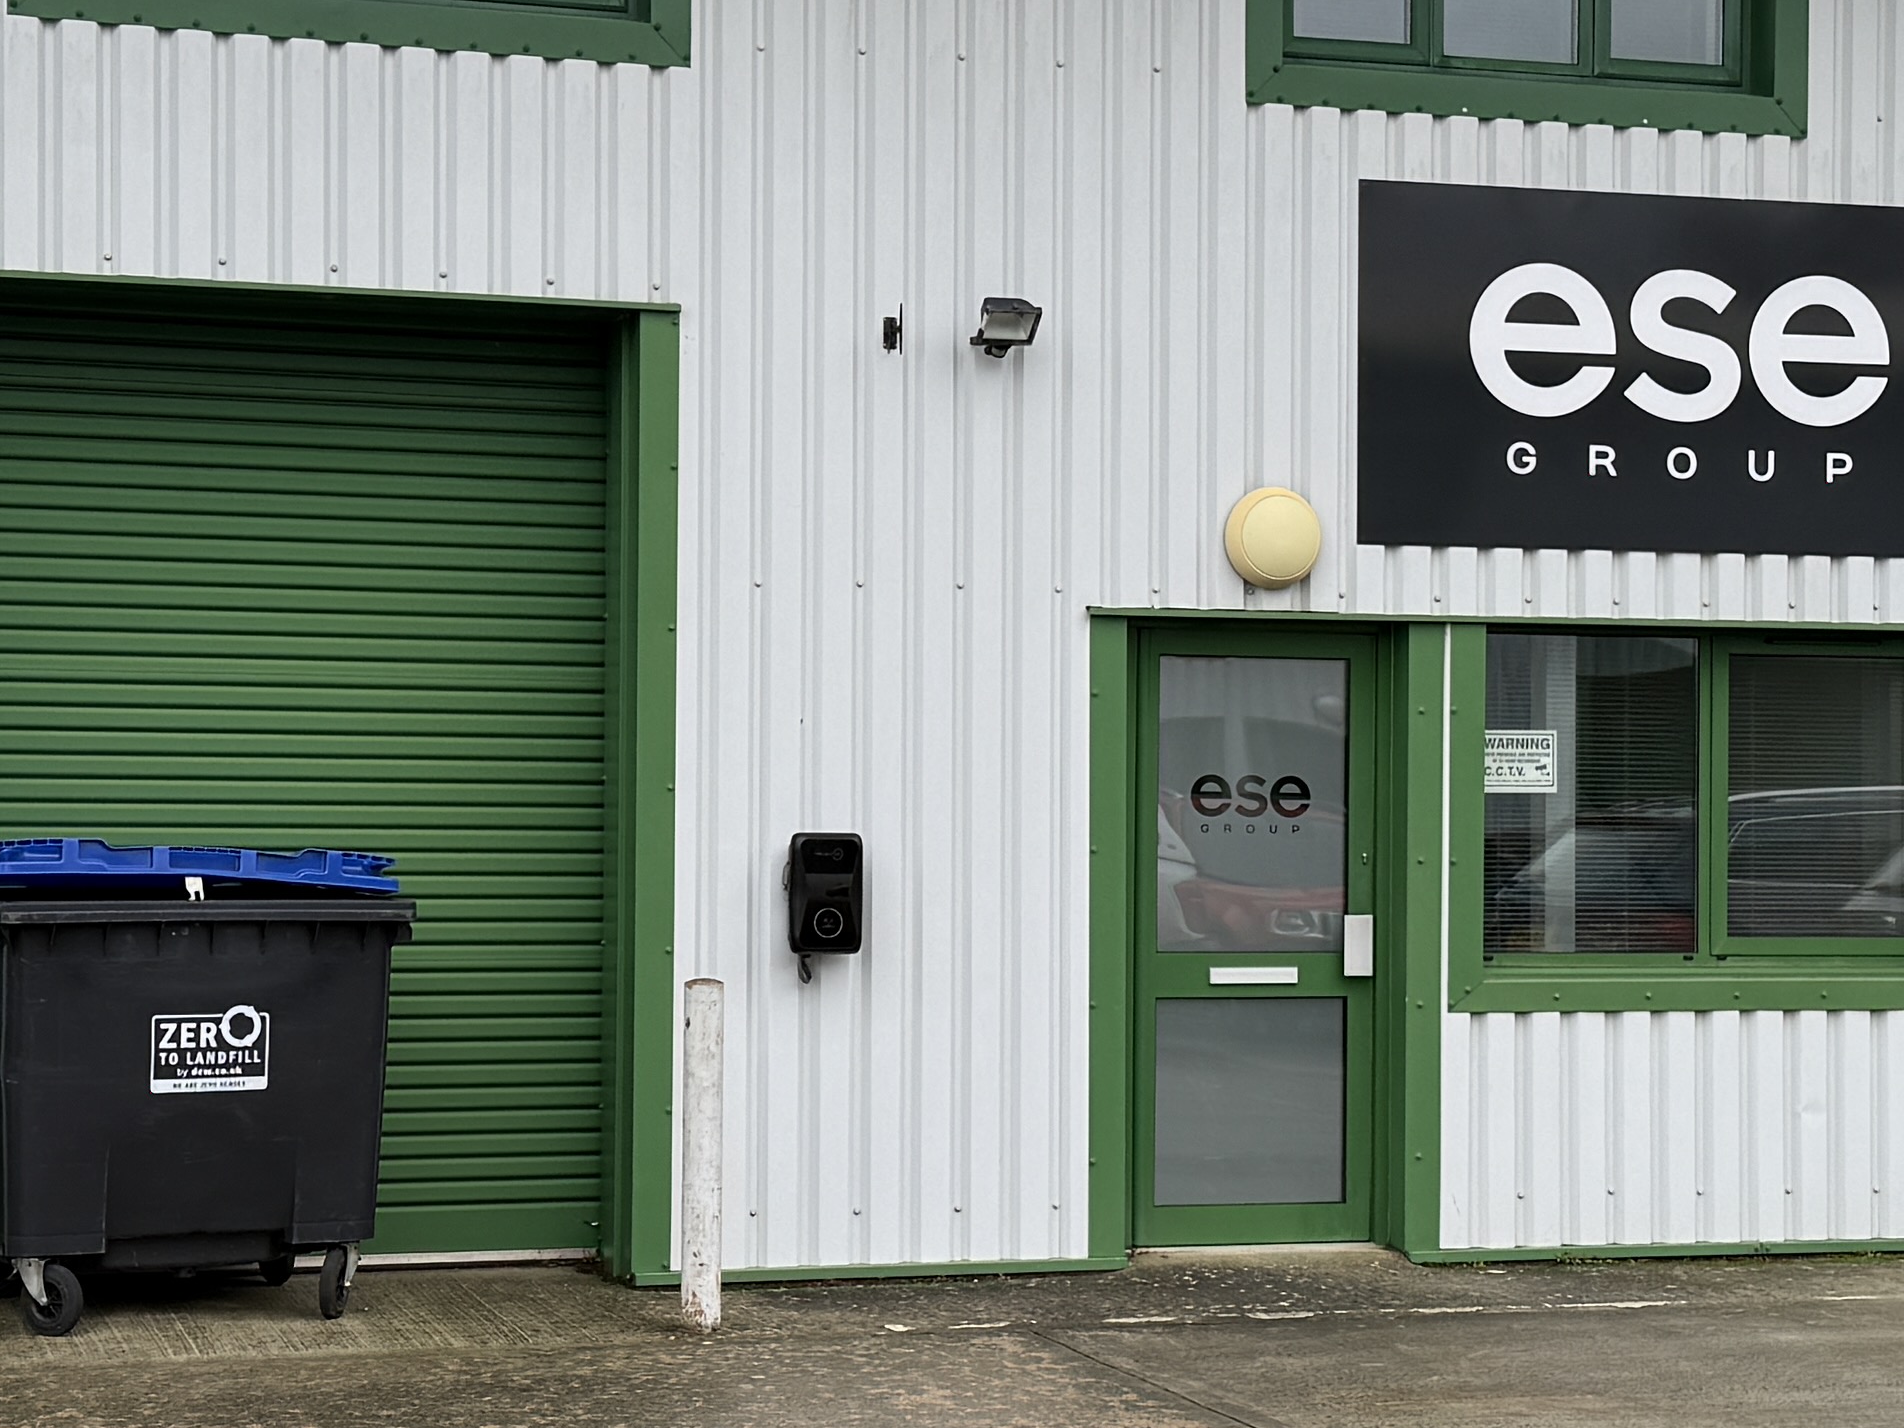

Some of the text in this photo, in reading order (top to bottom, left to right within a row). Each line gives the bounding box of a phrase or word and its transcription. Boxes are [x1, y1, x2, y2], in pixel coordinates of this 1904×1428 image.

[1469, 262, 1891, 428] ese
[1506, 441, 1854, 484] GROUP
[1484, 737, 1550, 750] WARNING
[1191, 774, 1311, 818] ese
[1200, 824, 1300, 834] GROUP
[159, 1005, 262, 1049] ZERO
[159, 1050, 262, 1066] TO LANDFILL
